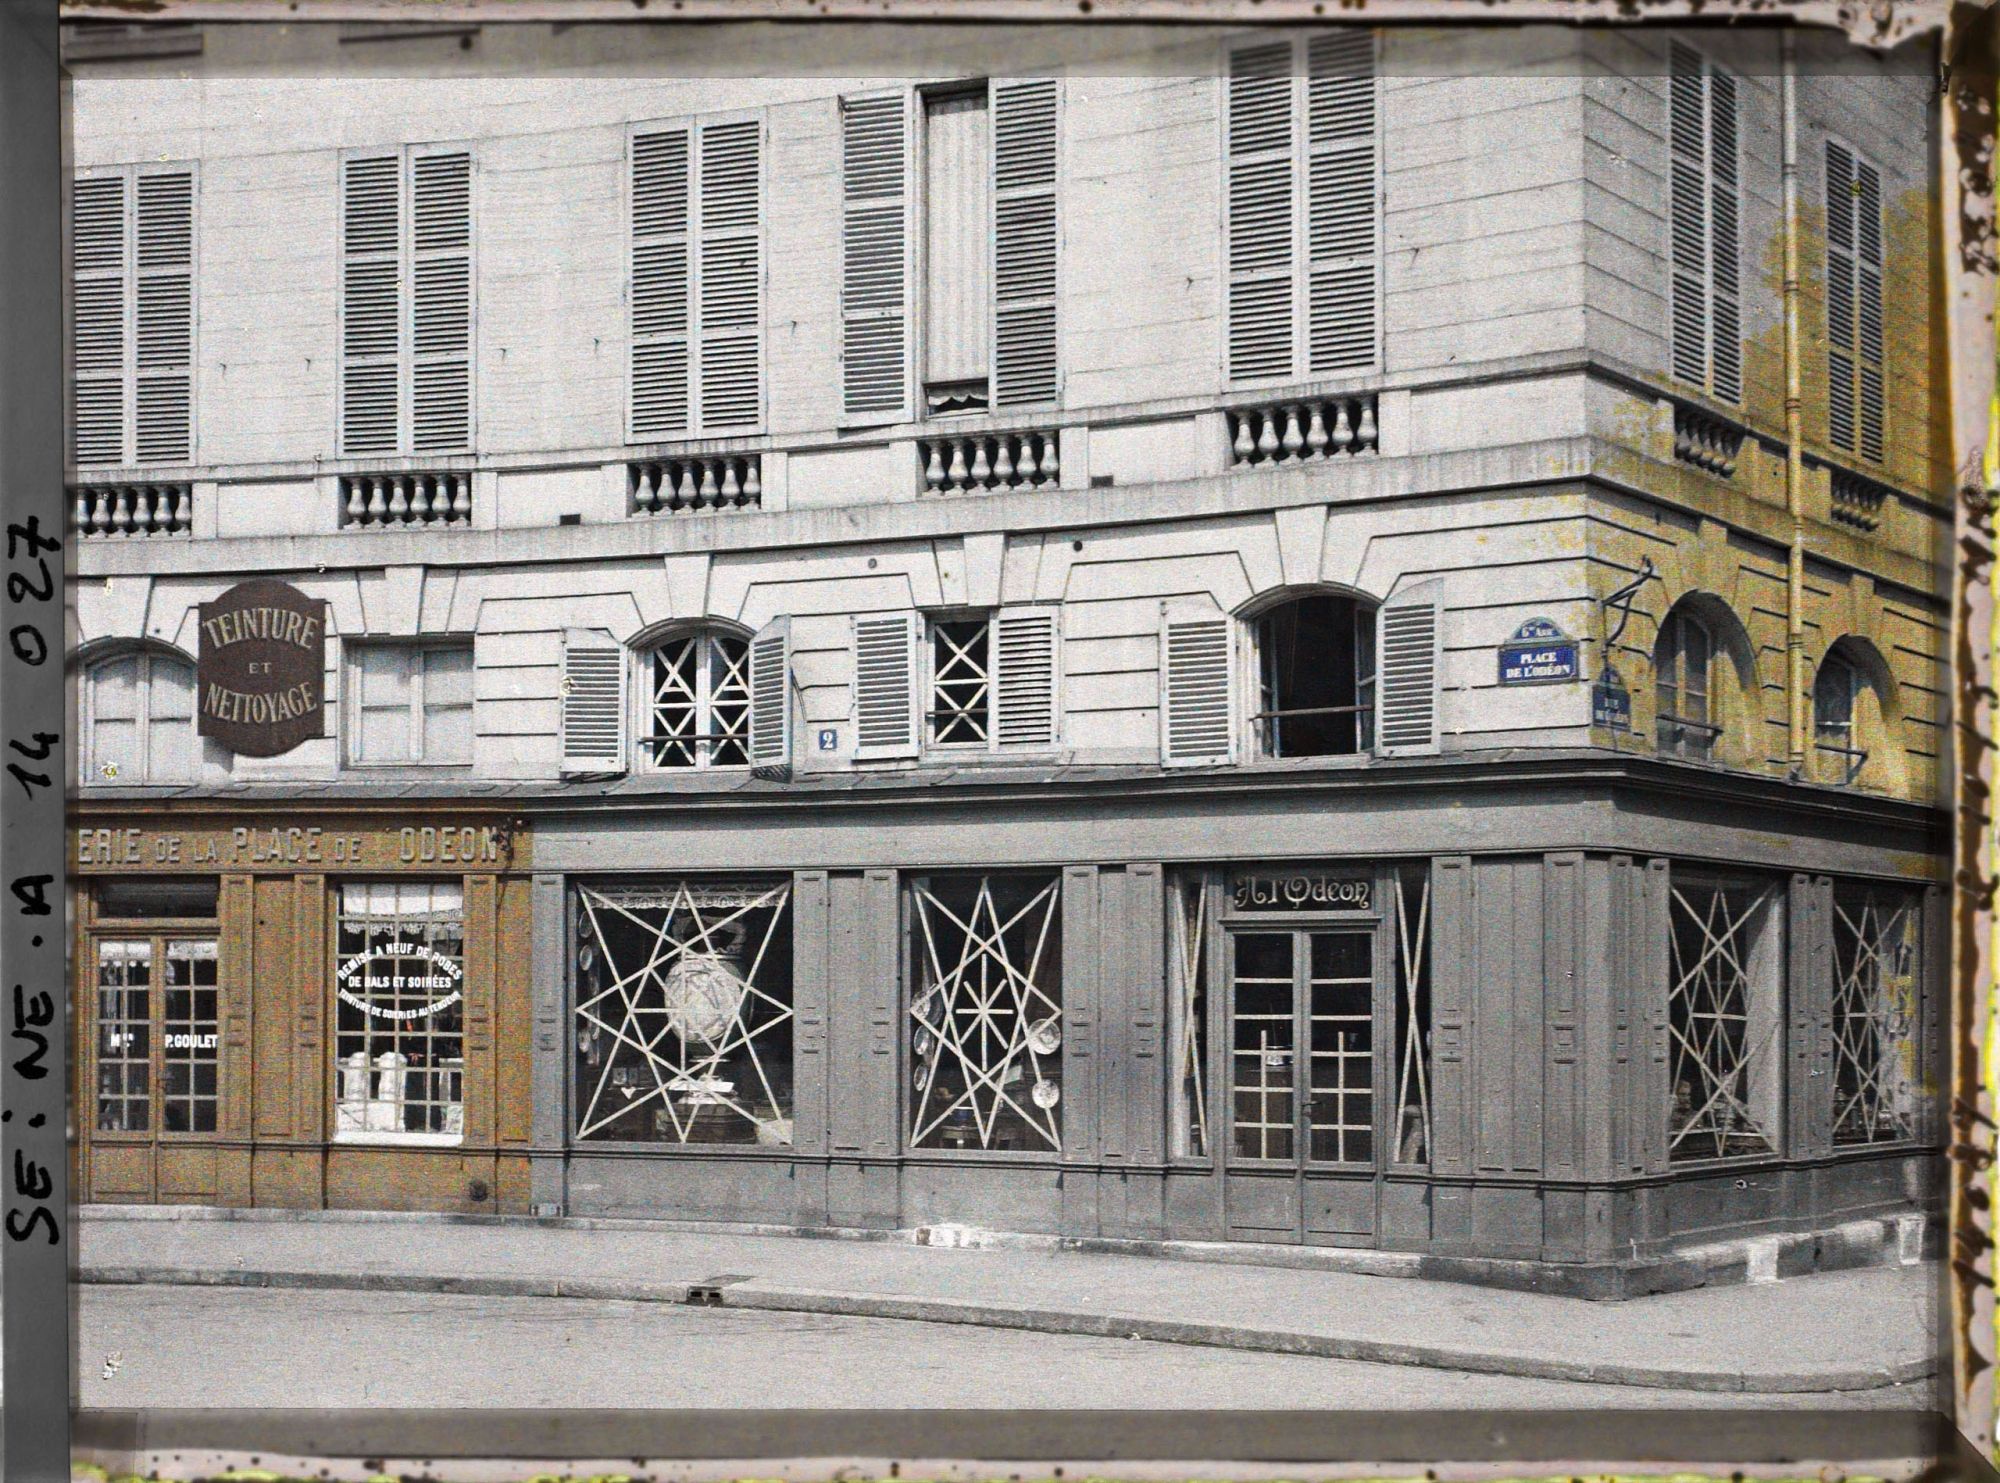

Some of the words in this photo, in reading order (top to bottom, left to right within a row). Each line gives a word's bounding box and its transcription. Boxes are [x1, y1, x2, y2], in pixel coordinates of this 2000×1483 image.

[7, 515, 62, 666] 027
[202, 607, 318, 650] TEINTURE
[249, 662, 272, 675] ET
[1506, 668, 1521, 679] DE
[1520, 652, 1557, 664] PLACE
[203, 681, 318, 724] NETTOYAGE
[822, 731, 834, 749] 2
[6, 731, 60, 801] 14
[78, 828, 142, 864] ERIE
[155, 838, 181, 863] DE
[195, 838, 218, 864] LA
[233, 827, 322, 863] PLACE
[336, 838, 362, 862] DE
[337, 949, 373, 980] REMISE
[375, 945, 384, 957] A
[386, 943, 414, 955] NEUF
[416, 945, 431, 959] DE
[432, 951, 463, 981] ROBES
[348, 976, 361, 988] DE
[364, 976, 390, 988] BALS
[393, 976, 406, 988] ET
[408, 974, 452, 988] SOIRÉES
[340, 987, 371, 1013] TEINTURE
[371, 1006, 381, 1017] DE
